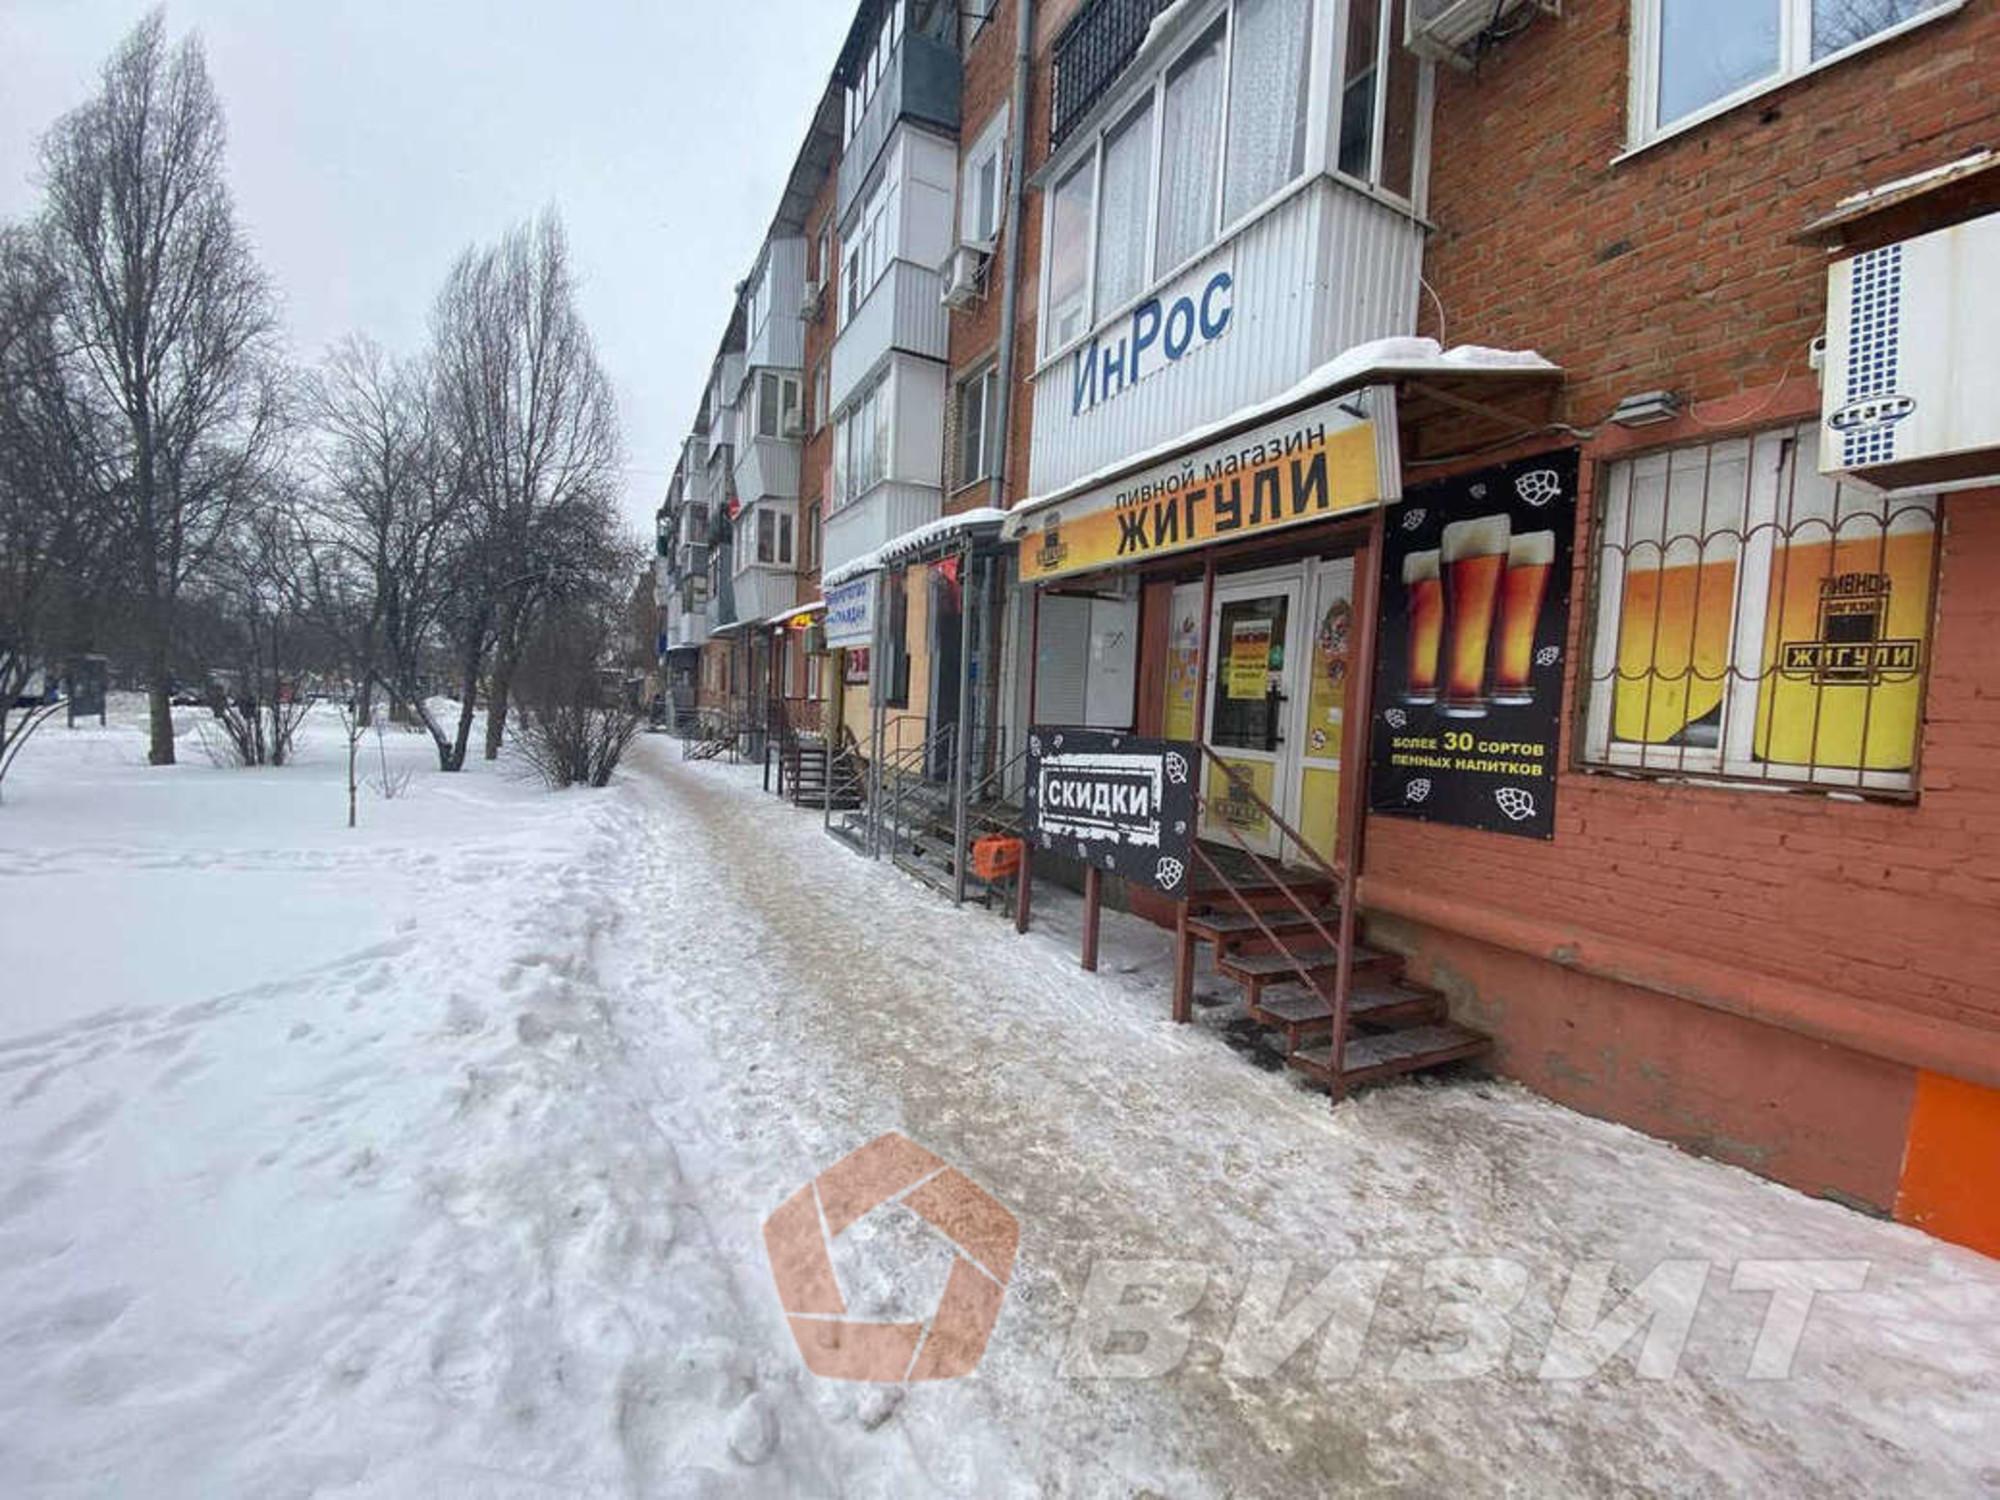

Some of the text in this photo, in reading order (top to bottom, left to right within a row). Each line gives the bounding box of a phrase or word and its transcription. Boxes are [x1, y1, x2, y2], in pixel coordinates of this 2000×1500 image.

[1115, 423, 1325, 509] пивной магазин
[1117, 451, 1329, 555] ЖИГУЛИ
[1791, 648, 1910, 668] ЖИГУЛИ
[1391, 731, 1545, 757] БОЛЕЕ 30 СОРТОВ
[1391, 754, 1543, 776] ПЕННЫХ НАПИТКОВ
[1048, 779, 1149, 818] СКИДКИ
